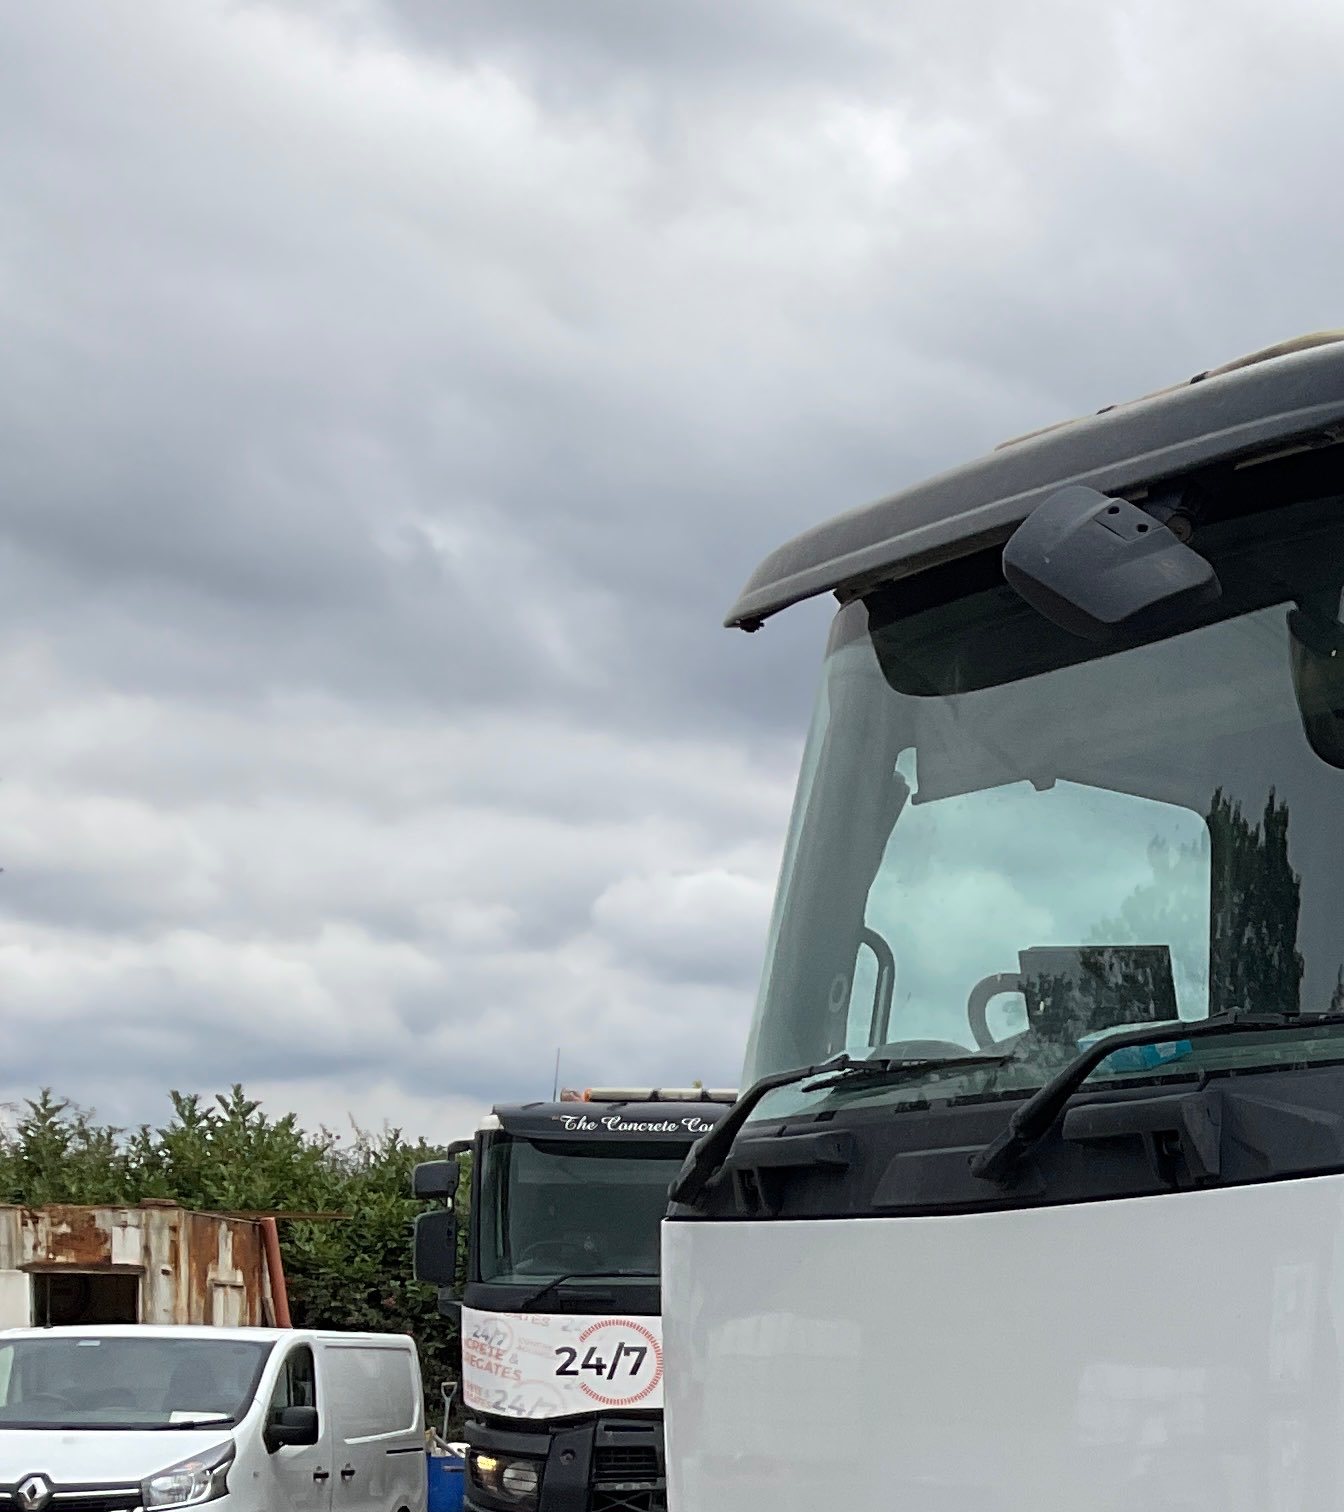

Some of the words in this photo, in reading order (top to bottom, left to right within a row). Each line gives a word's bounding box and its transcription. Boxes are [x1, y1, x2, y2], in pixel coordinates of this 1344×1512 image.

[560, 1114, 598, 1132] The
[601, 1114, 680, 1132] Concrete
[555, 1341, 648, 1380] 24/7
